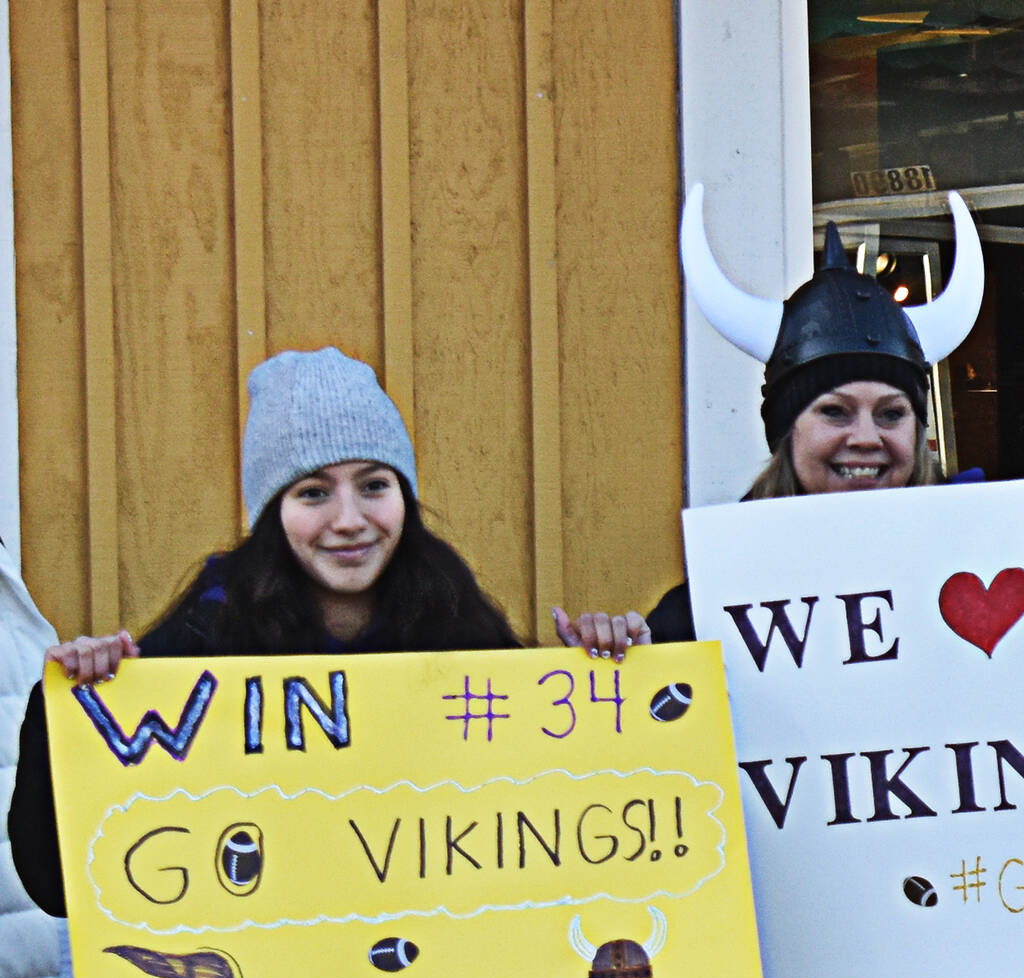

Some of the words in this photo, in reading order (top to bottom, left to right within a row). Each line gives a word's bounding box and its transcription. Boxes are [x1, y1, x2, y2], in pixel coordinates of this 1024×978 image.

[723, 589, 900, 673] WE
[71, 669, 350, 767] WIN
[124, 822, 264, 904] GO
[349, 797, 689, 883] VIKINGS!!
